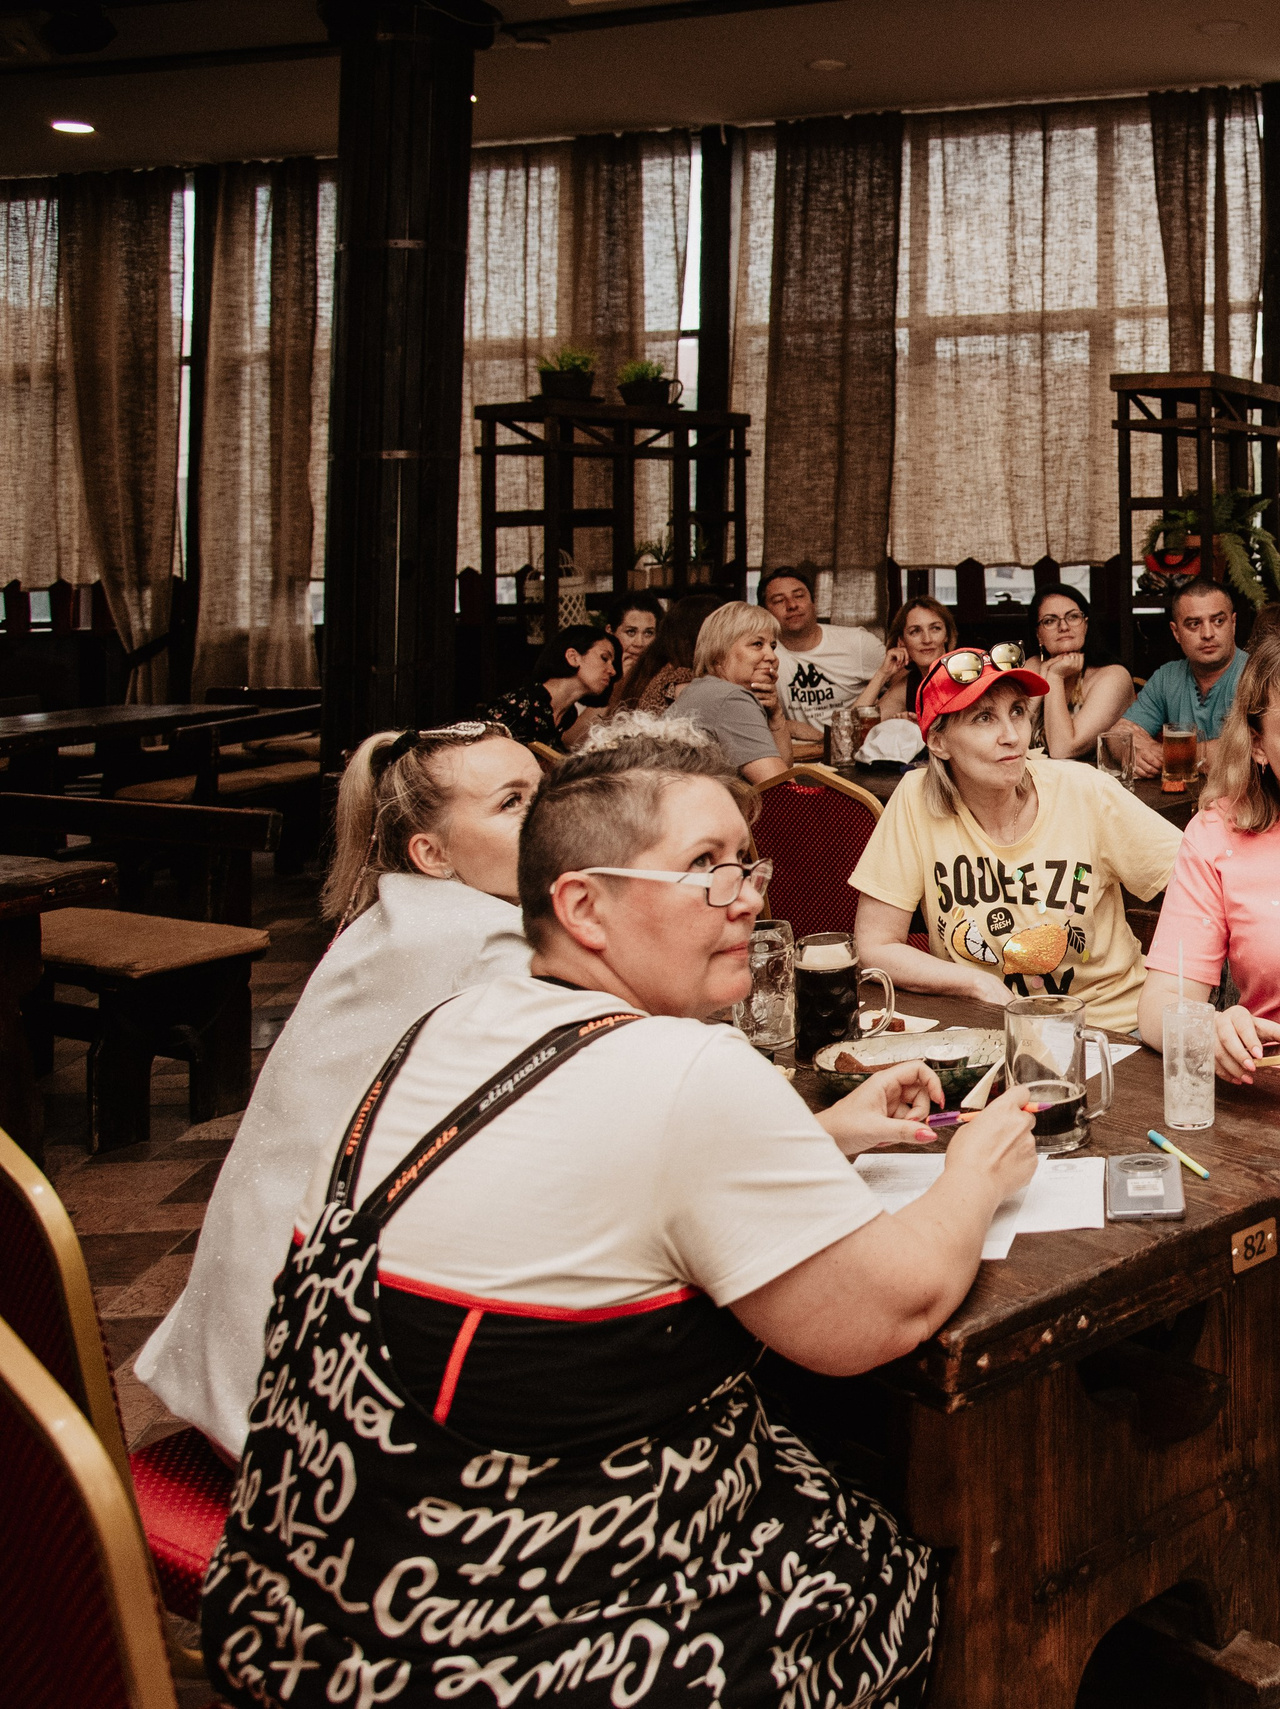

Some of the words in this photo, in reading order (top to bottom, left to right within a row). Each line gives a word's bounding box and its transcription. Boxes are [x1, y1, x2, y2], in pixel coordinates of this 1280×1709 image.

[791, 687, 834, 705] Kappa
[934, 854, 1093, 915] SQUEEZE
[990, 918, 1012, 932] FRESH
[991, 912, 1005, 923] SO
[478, 1046, 557, 1114] etiquette
[387, 1126, 459, 1203] etiquette
[1243, 1229, 1268, 1261] 82
